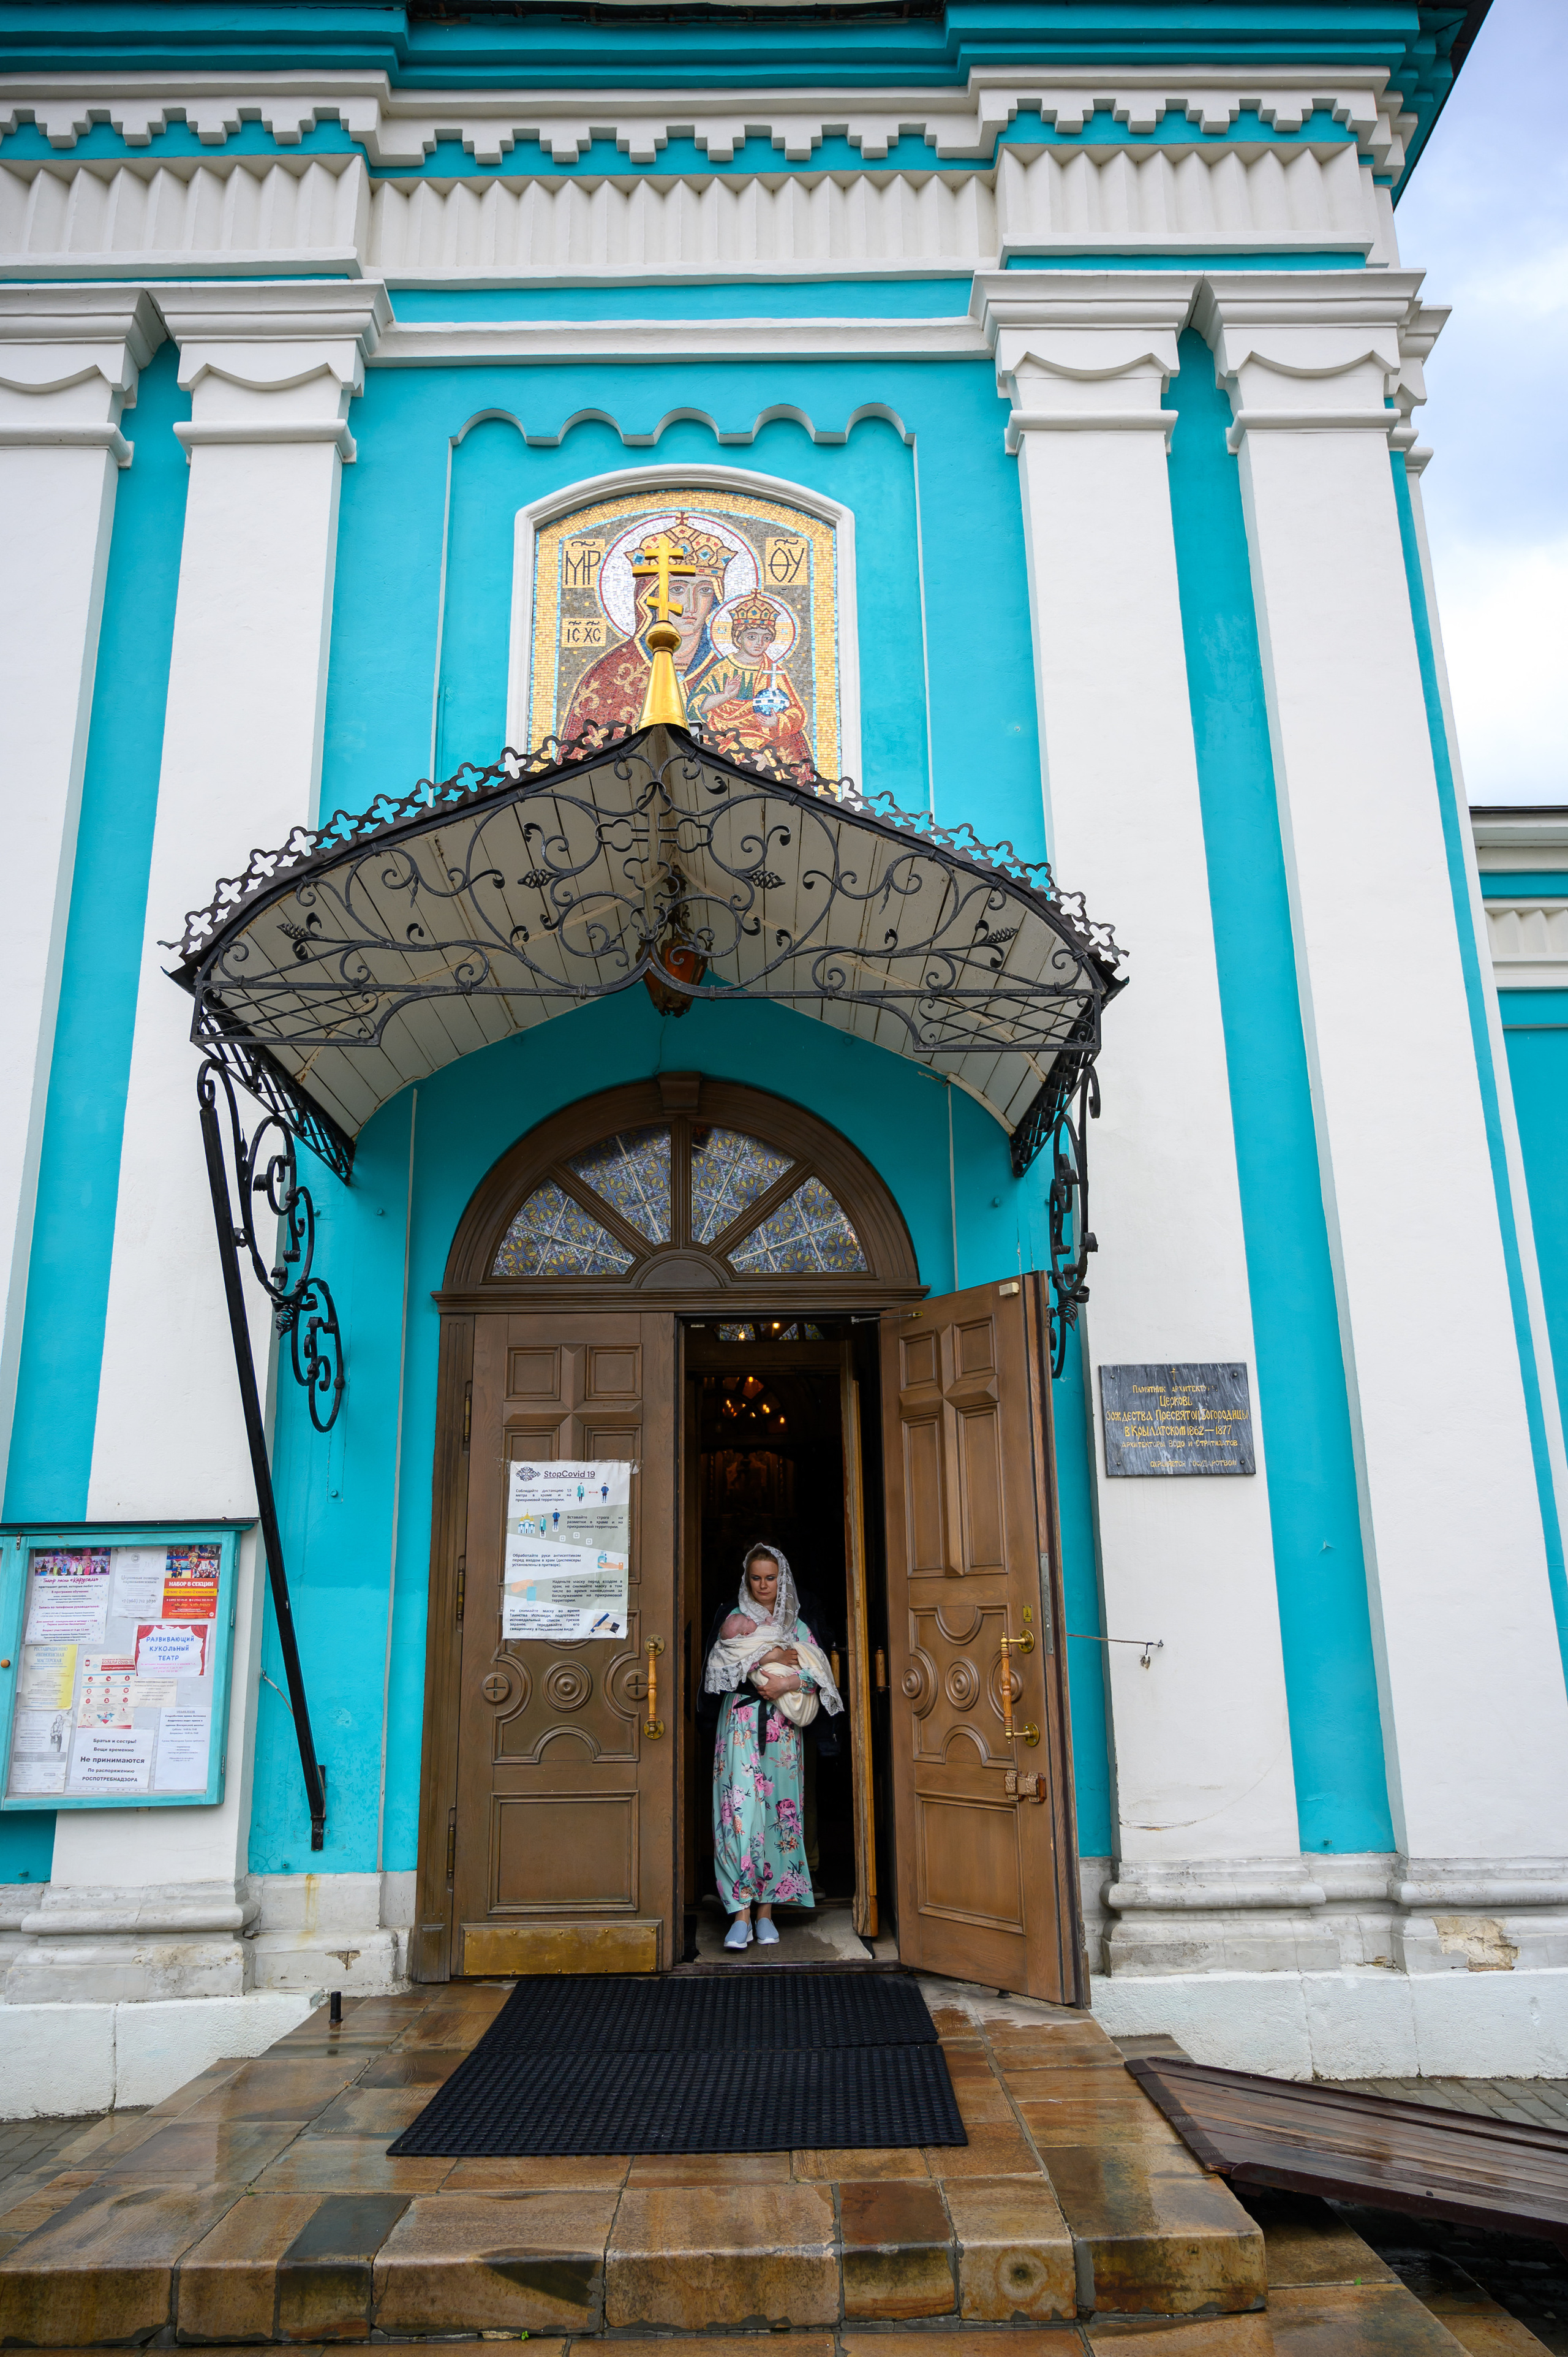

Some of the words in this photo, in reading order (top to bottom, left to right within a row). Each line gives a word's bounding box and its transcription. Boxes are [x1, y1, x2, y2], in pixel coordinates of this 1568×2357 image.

[1159, 1395, 1193, 1408] ЦЕРКОВЬ
[1156, 1409, 1200, 1423] ПРЕСВЯТОЙ
[1201, 1409, 1248, 1423] БОГОРОДИЦЫ
[1131, 1424, 1186, 1439] КРЫЛАТСКОМ
[1169, 1440, 1185, 1448] ВОДО
